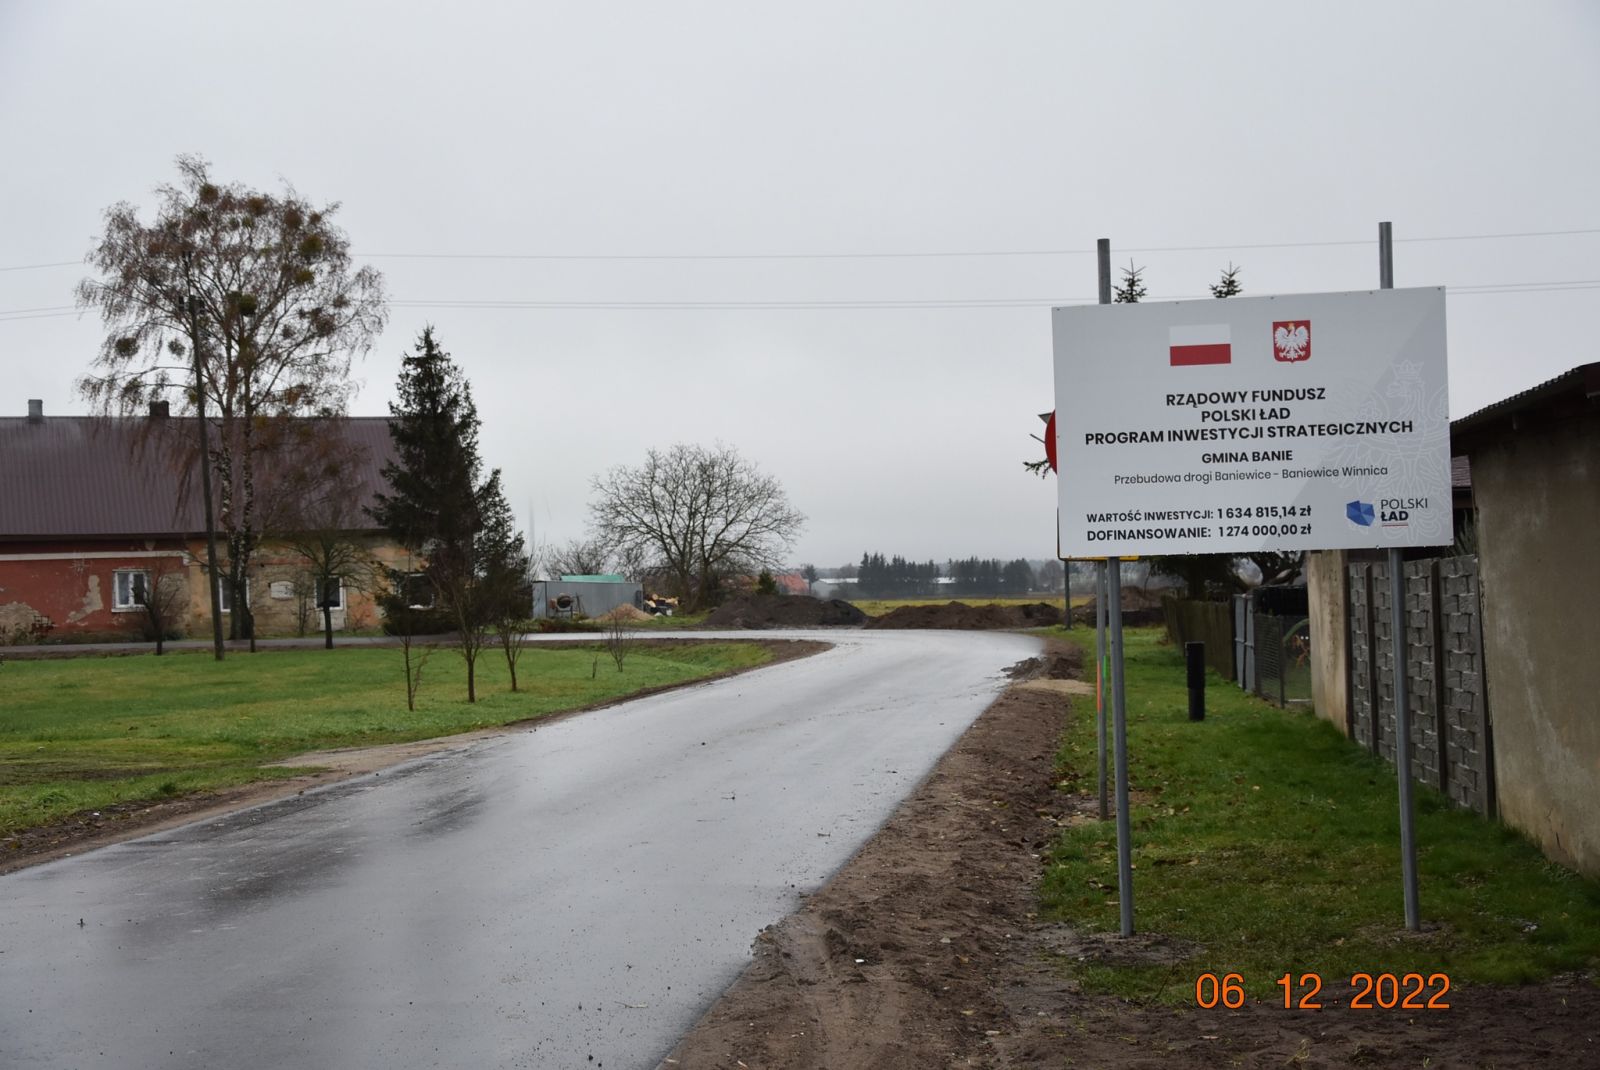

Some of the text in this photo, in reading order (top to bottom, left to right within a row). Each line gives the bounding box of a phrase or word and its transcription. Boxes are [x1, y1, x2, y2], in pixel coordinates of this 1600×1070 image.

[1166, 387, 1326, 408] RZĄDOWY FUNDUSZ
[1201, 407, 1291, 423] POLSKI ŁAD
[1085, 420, 1413, 445] PROGRAM INWESTYCJI STRATEGICZNYCH
[1201, 450, 1293, 464] GMINA BANIE
[1114, 473, 1181, 485] Przebudowa
[1184, 471, 1213, 484] drogi
[1215, 469, 1271, 481] Baniewice
[1282, 468, 1339, 479] Baniewice
[1342, 465, 1388, 477] Winnica
[1380, 498, 1428, 510] POLSKI
[1086, 505, 1312, 523] WARTOŚĆ INWESTYCJI: 1 634 815,14 zł
[1380, 510, 1409, 522] ŁAD
[1087, 523, 1312, 541] DOFINANSOWANIE: 1 274 000,00 zł
